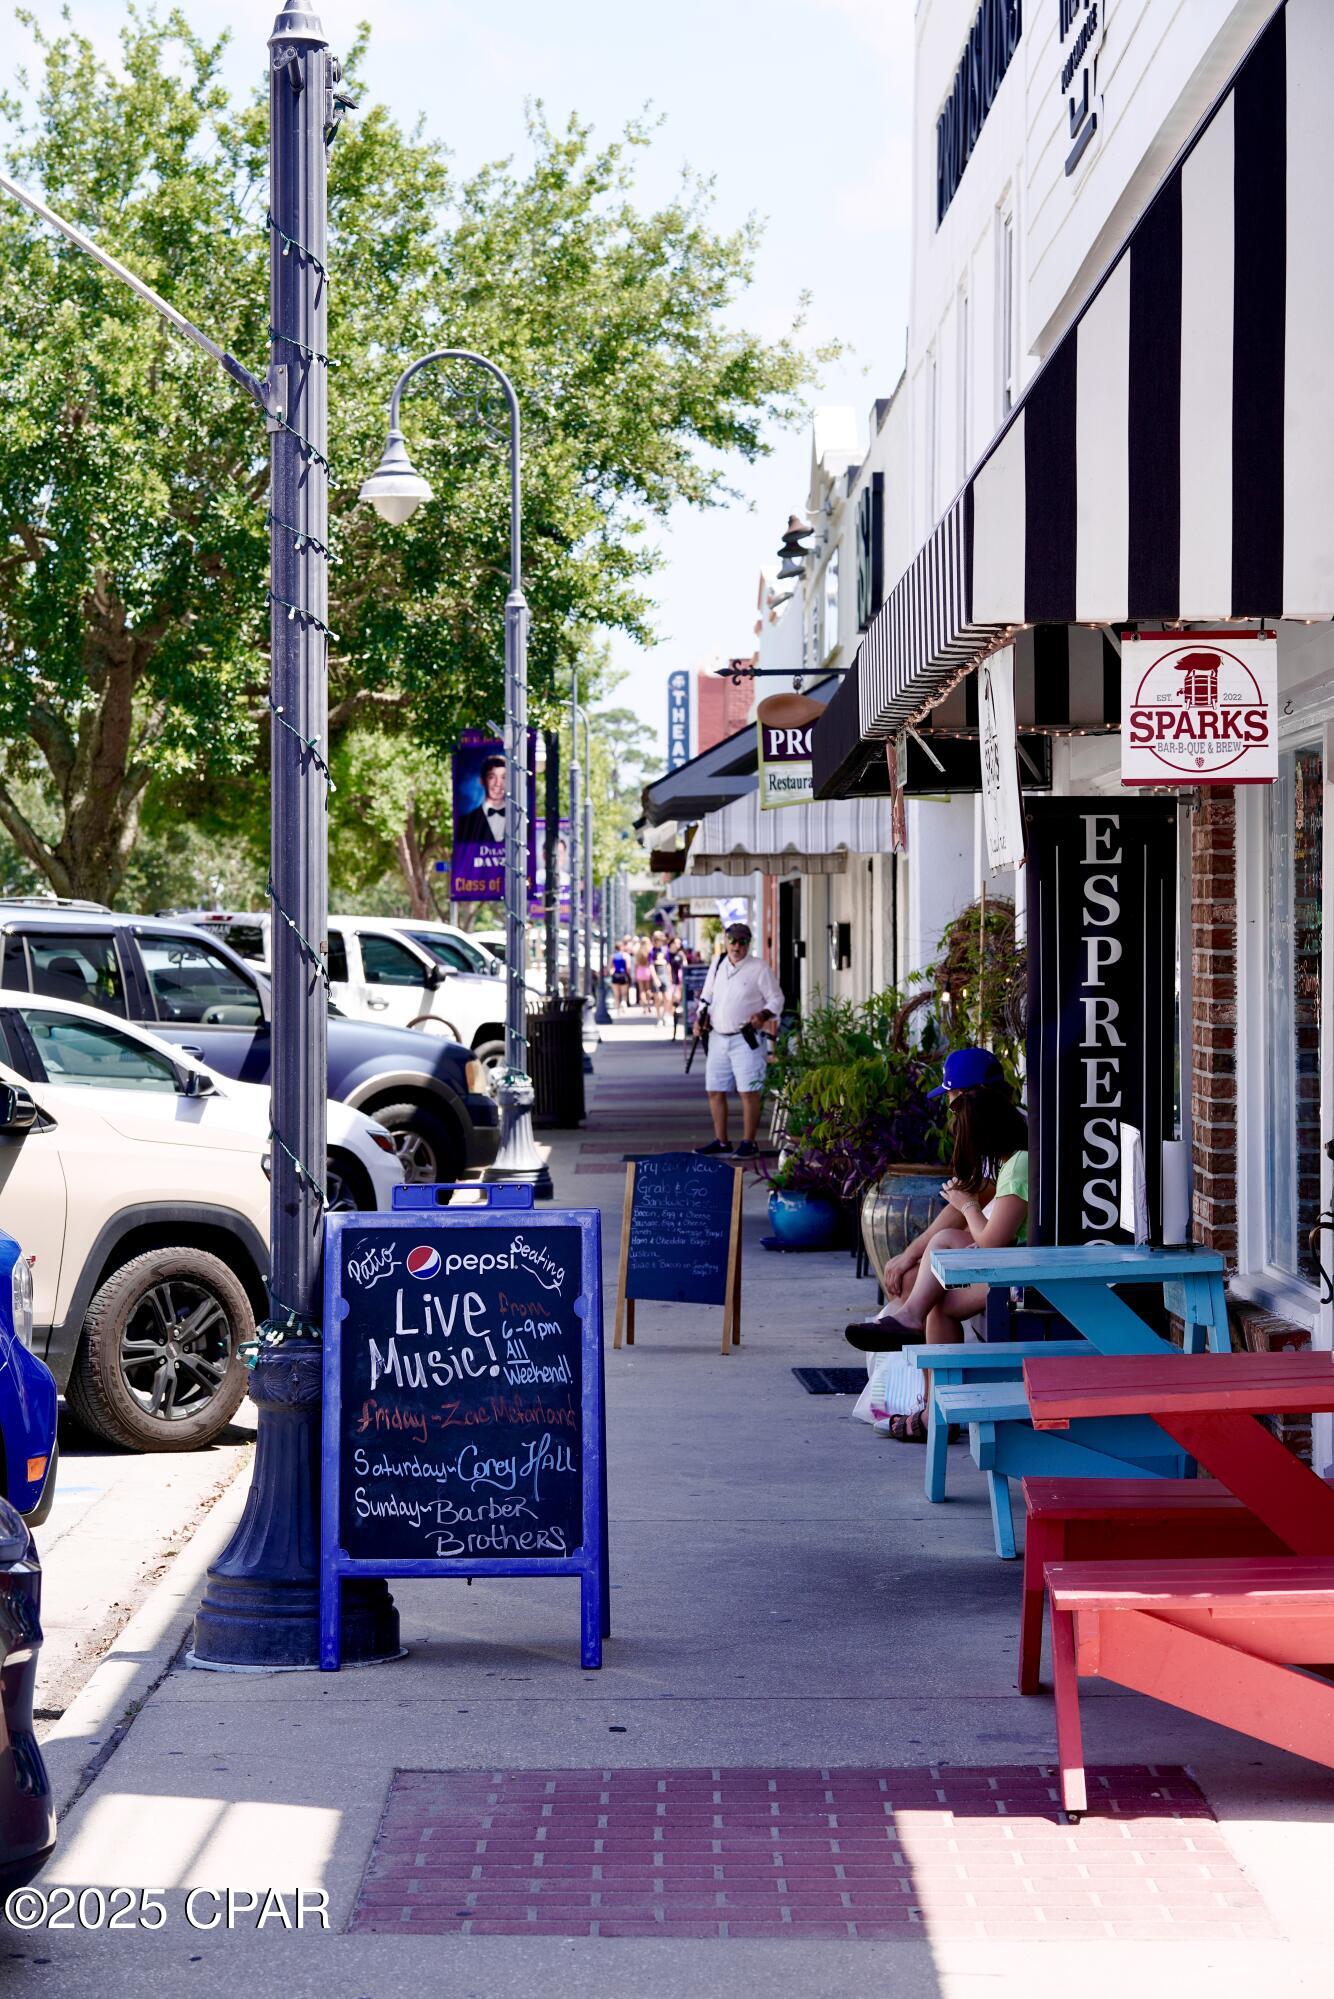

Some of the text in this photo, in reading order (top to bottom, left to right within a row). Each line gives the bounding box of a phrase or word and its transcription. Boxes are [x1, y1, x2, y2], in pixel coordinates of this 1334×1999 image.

[1156, 693, 1242, 702] EST. 2022
[1130, 709, 1269, 743] SPARKS
[1157, 741, 1242, 756] BAR-B-QUE & BREW
[455, 876, 502, 892] Class of
[1078, 814, 1127, 1246] ESPRESS
[636, 1160, 659, 1176] Try
[637, 1175, 671, 1194] Grab
[684, 1179, 708, 1199] Go
[662, 1208, 676, 1220] Egg
[631, 1235, 648, 1245] Ham
[656, 1235, 686, 1245] Cheddar
[348, 1241, 397, 1285] Patio
[445, 1250, 516, 1275] pepsi
[510, 1235, 566, 1288] Seating
[395, 1288, 491, 1337] Live
[502, 1319, 562, 1341] 6-9pm
[506, 1338, 529, 1360] All
[368, 1336, 500, 1391] Music!
[503, 1354, 574, 1387] Weekend!
